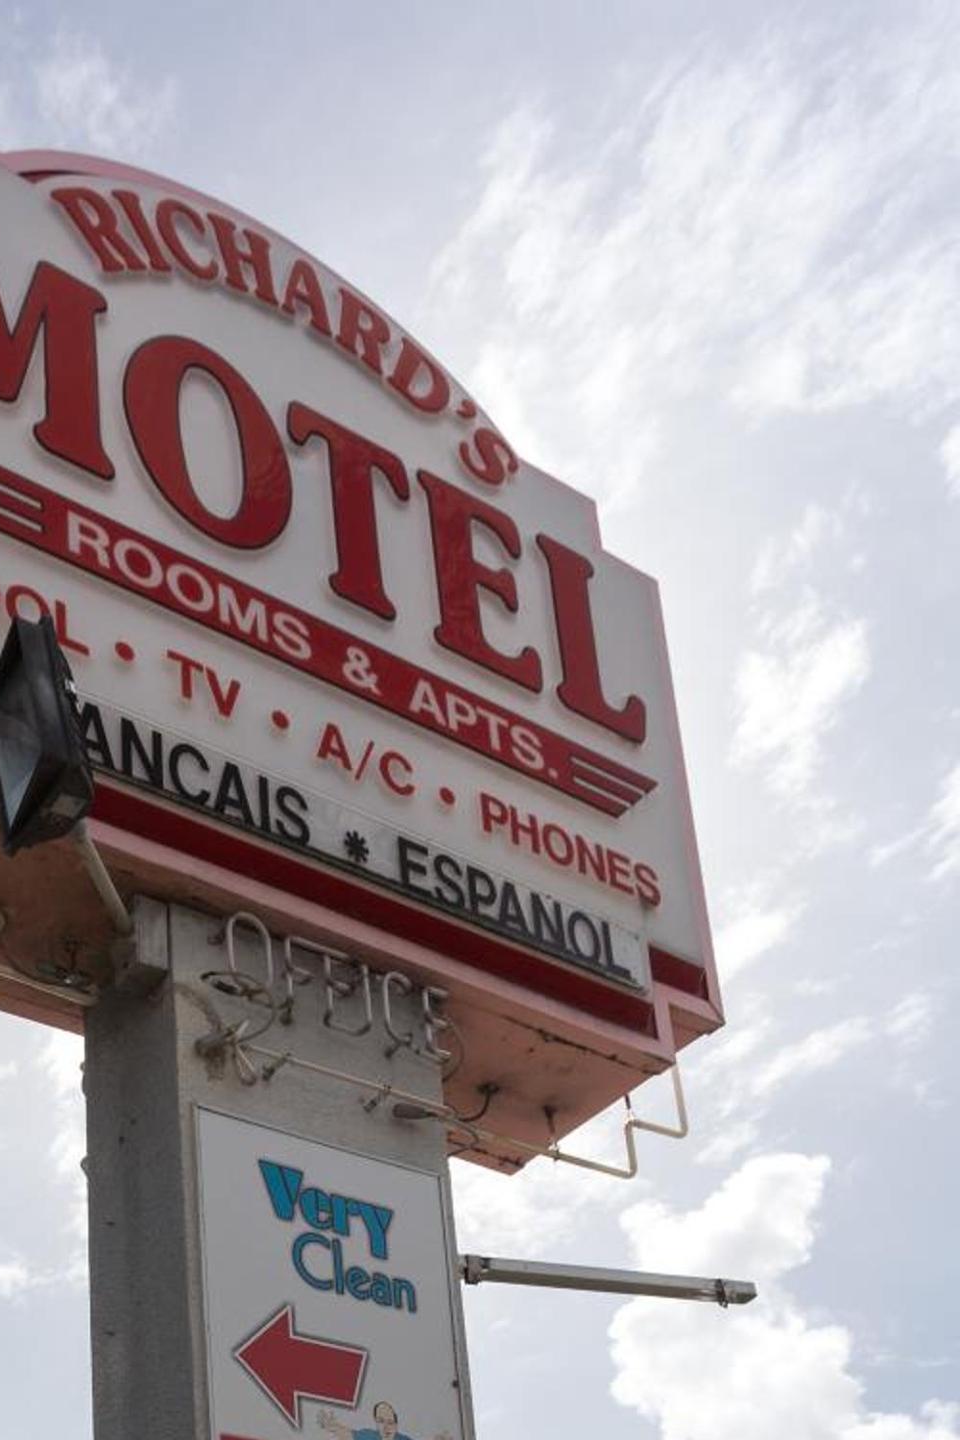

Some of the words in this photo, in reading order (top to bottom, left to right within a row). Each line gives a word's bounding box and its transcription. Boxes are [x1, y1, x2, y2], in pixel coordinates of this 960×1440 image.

[51, 186, 520, 487] RICHARD'S
[66, 509, 312, 662] ROOMS
[344, 646, 383, 695] &
[408, 680, 560, 780] APTS.
[166, 648, 241, 719] TV
[316, 721, 416, 796] A/C
[479, 793, 662, 907] PHONES
[291, 1231, 418, 1313] Clean
